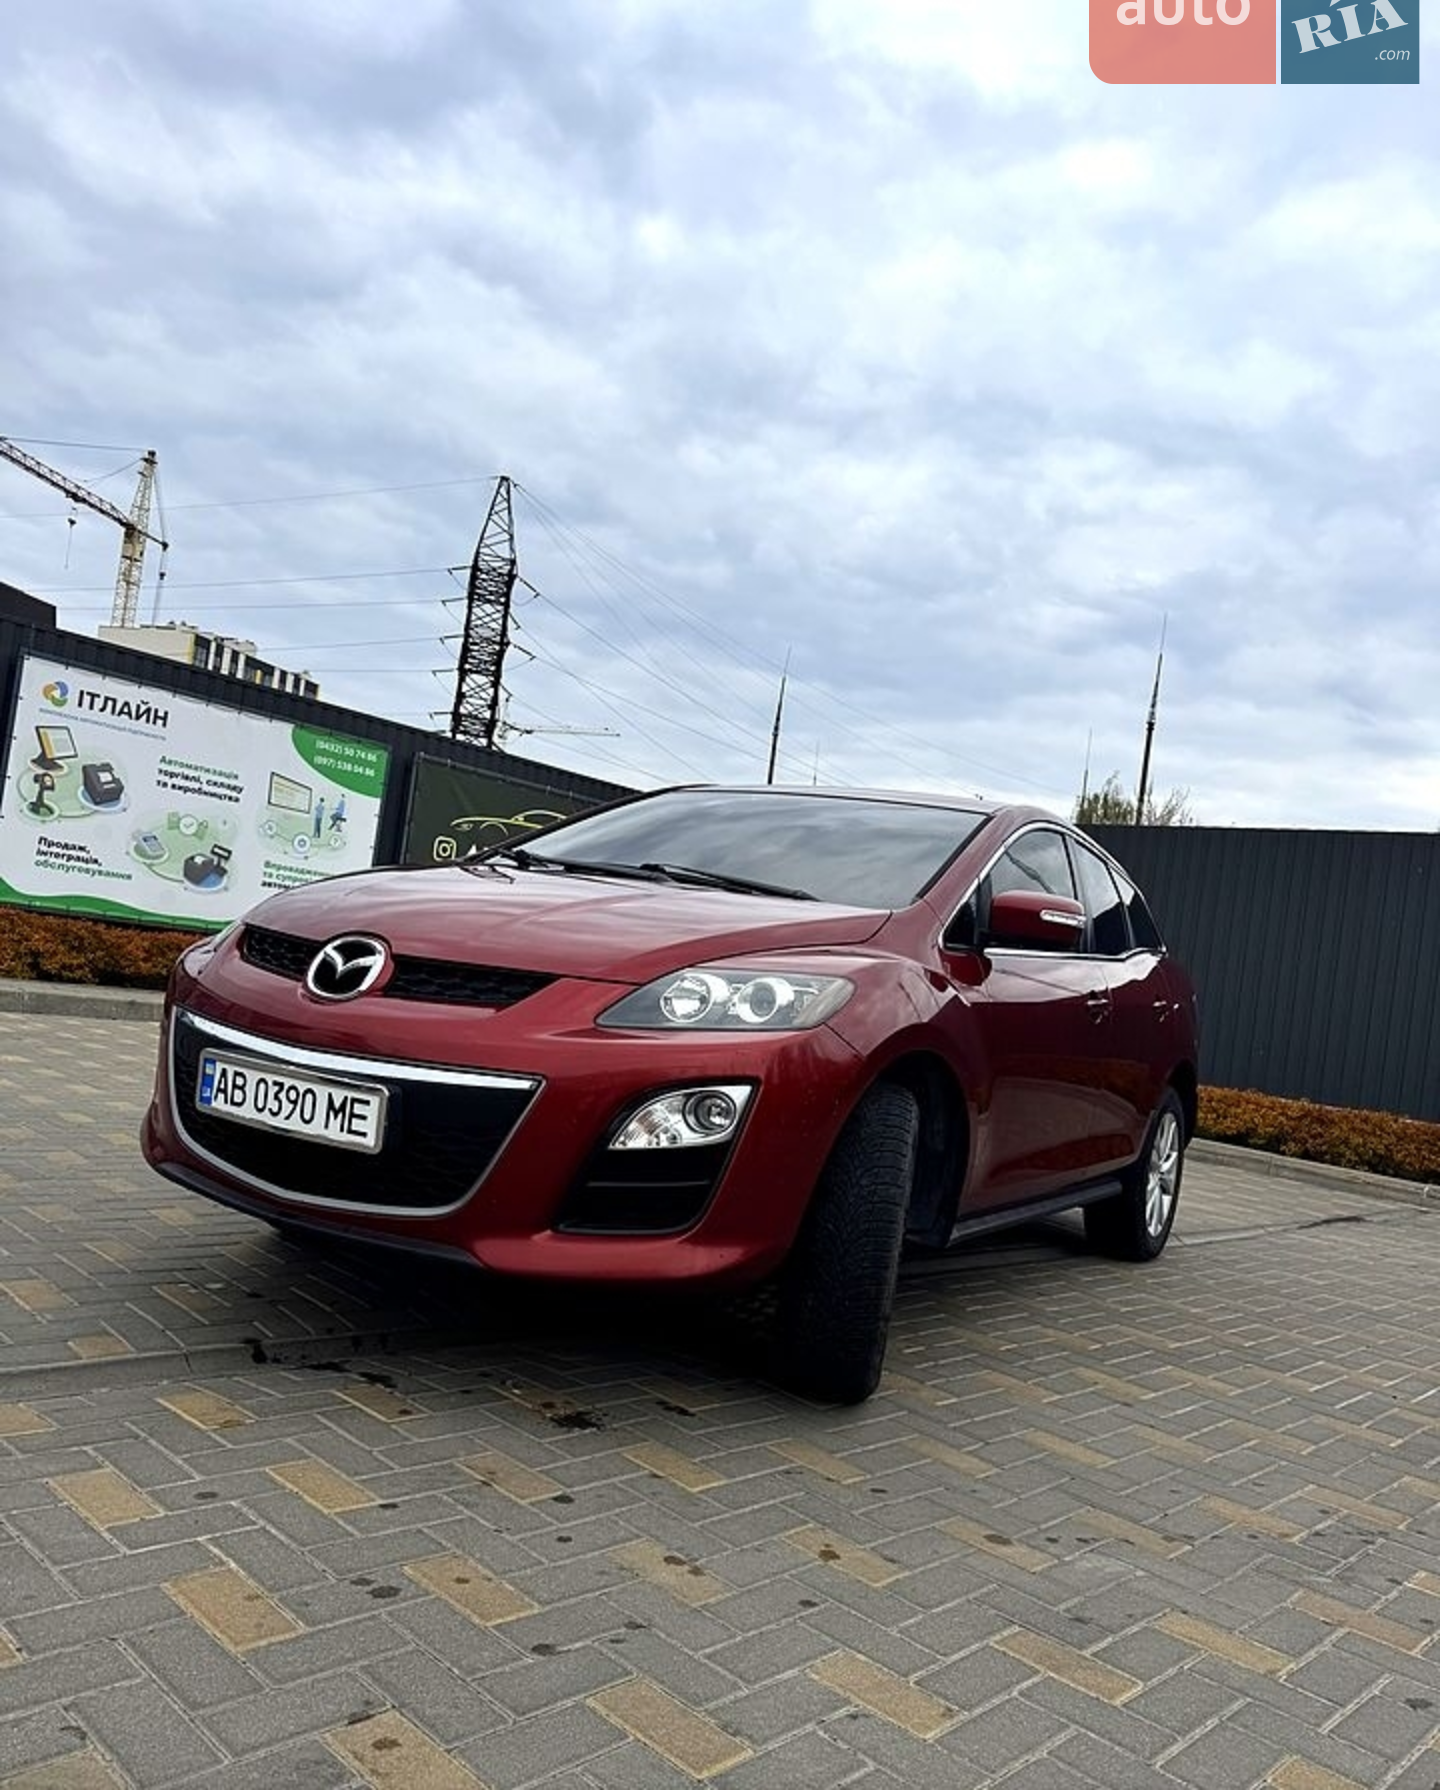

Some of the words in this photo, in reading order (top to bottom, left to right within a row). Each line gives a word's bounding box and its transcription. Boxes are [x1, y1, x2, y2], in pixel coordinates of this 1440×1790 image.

[77, 689, 169, 729] ІТЛАЙН
[159, 755, 239, 780] Автоматизація
[156, 779, 169, 789] та
[170, 783, 240, 803] виробництва
[205, 779, 244, 795] складу
[37, 835, 91, 854] Продаж,
[34, 859, 133, 880] обслуговування
[214, 1067, 247, 1108] AB
[253, 1077, 317, 1125] 0390
[323, 1092, 371, 1138] ME
